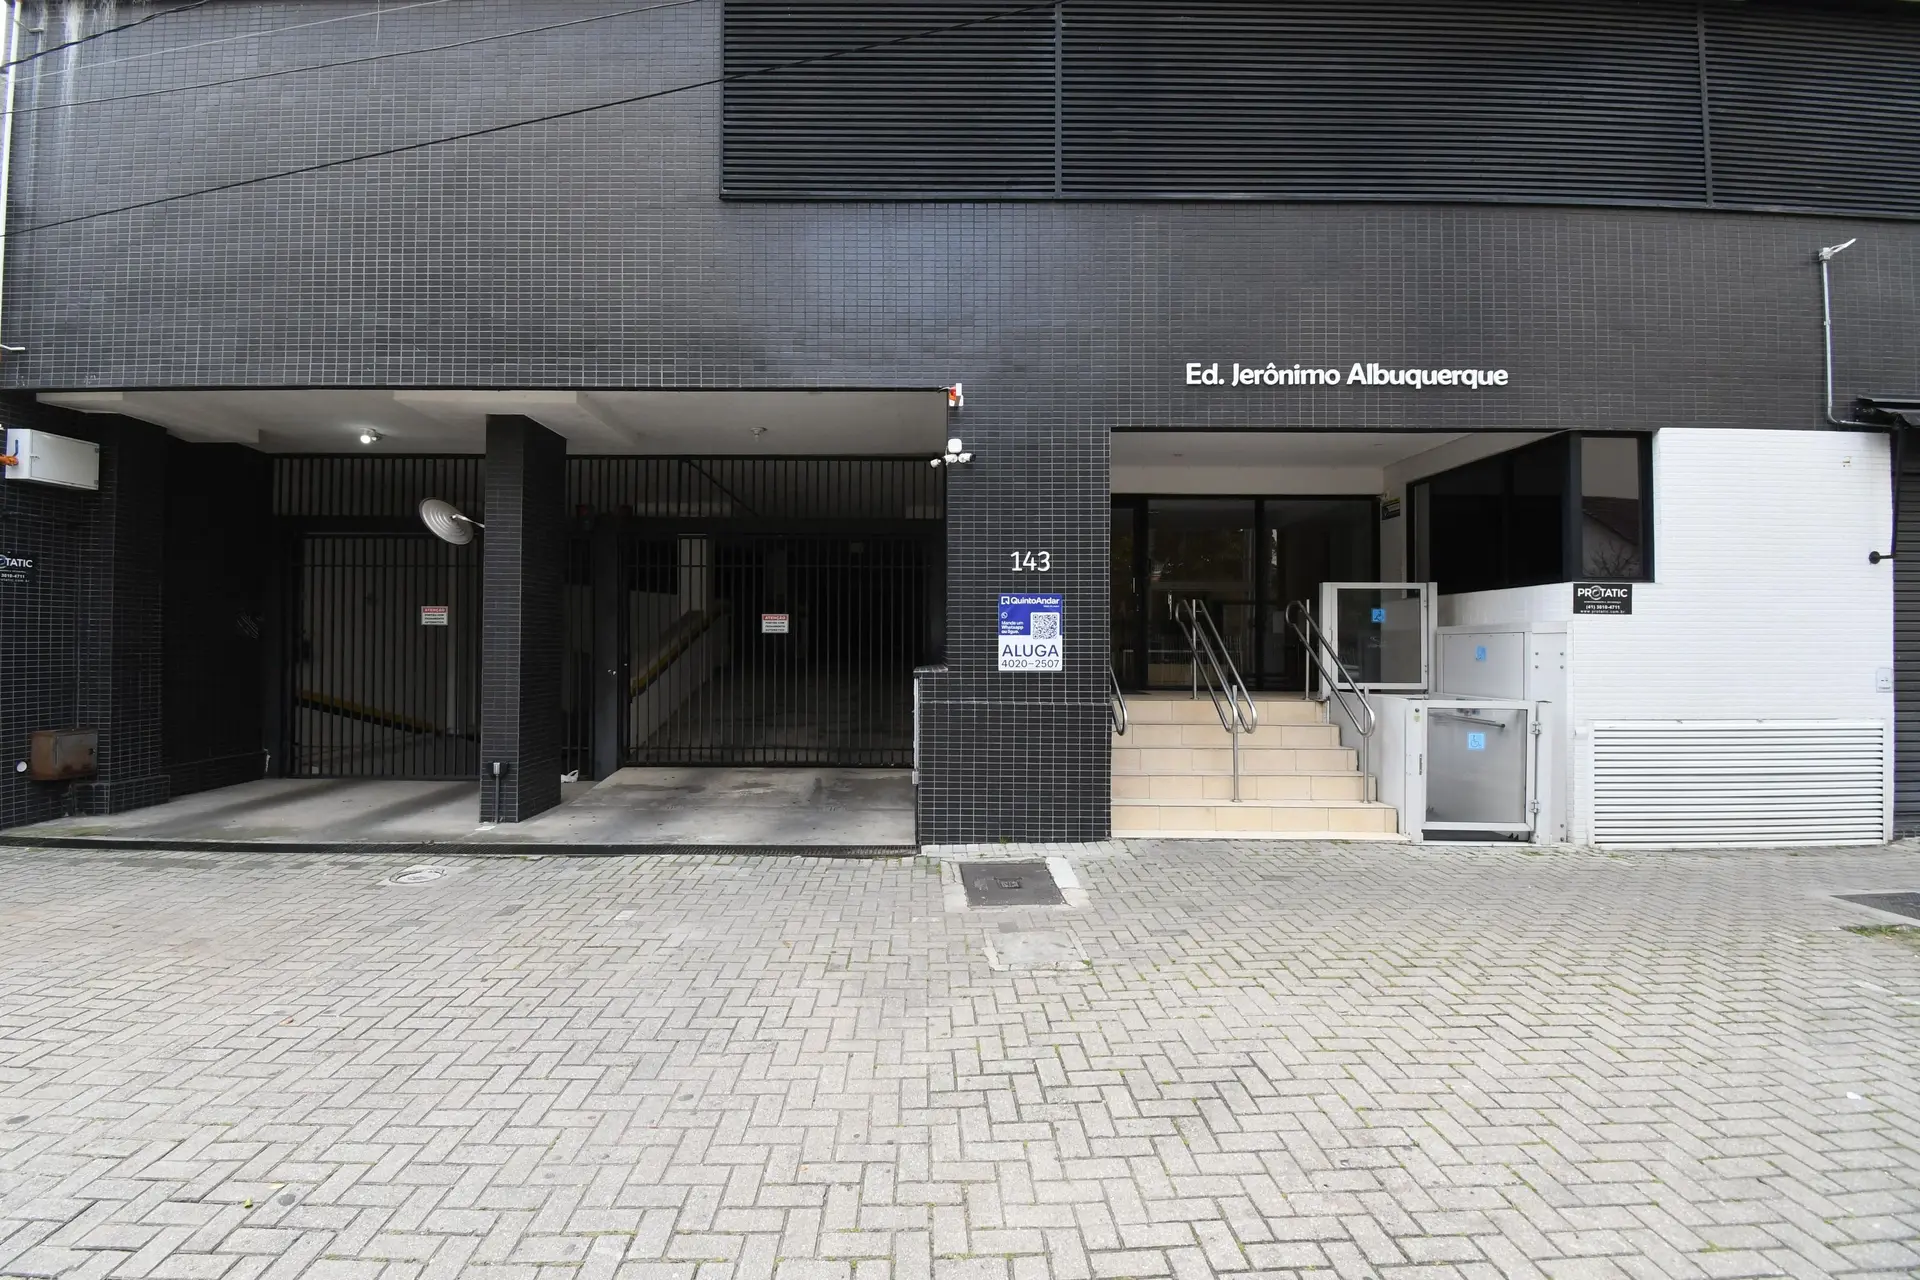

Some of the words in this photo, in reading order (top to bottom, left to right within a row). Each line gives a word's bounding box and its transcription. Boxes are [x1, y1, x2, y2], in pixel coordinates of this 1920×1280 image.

[1186, 363, 1225, 385] Ed.
[1231, 362, 1341, 387] Jerônimo
[1346, 362, 1509, 389] Albuquerque
[1010, 551, 1050, 571] 143
[1577, 585, 1628, 600] PROTATIC
[1010, 596, 1060, 605] QuintoAndar
[1002, 644, 1059, 657] ALUGA
[1001, 659, 1060, 668] 4020-2507
